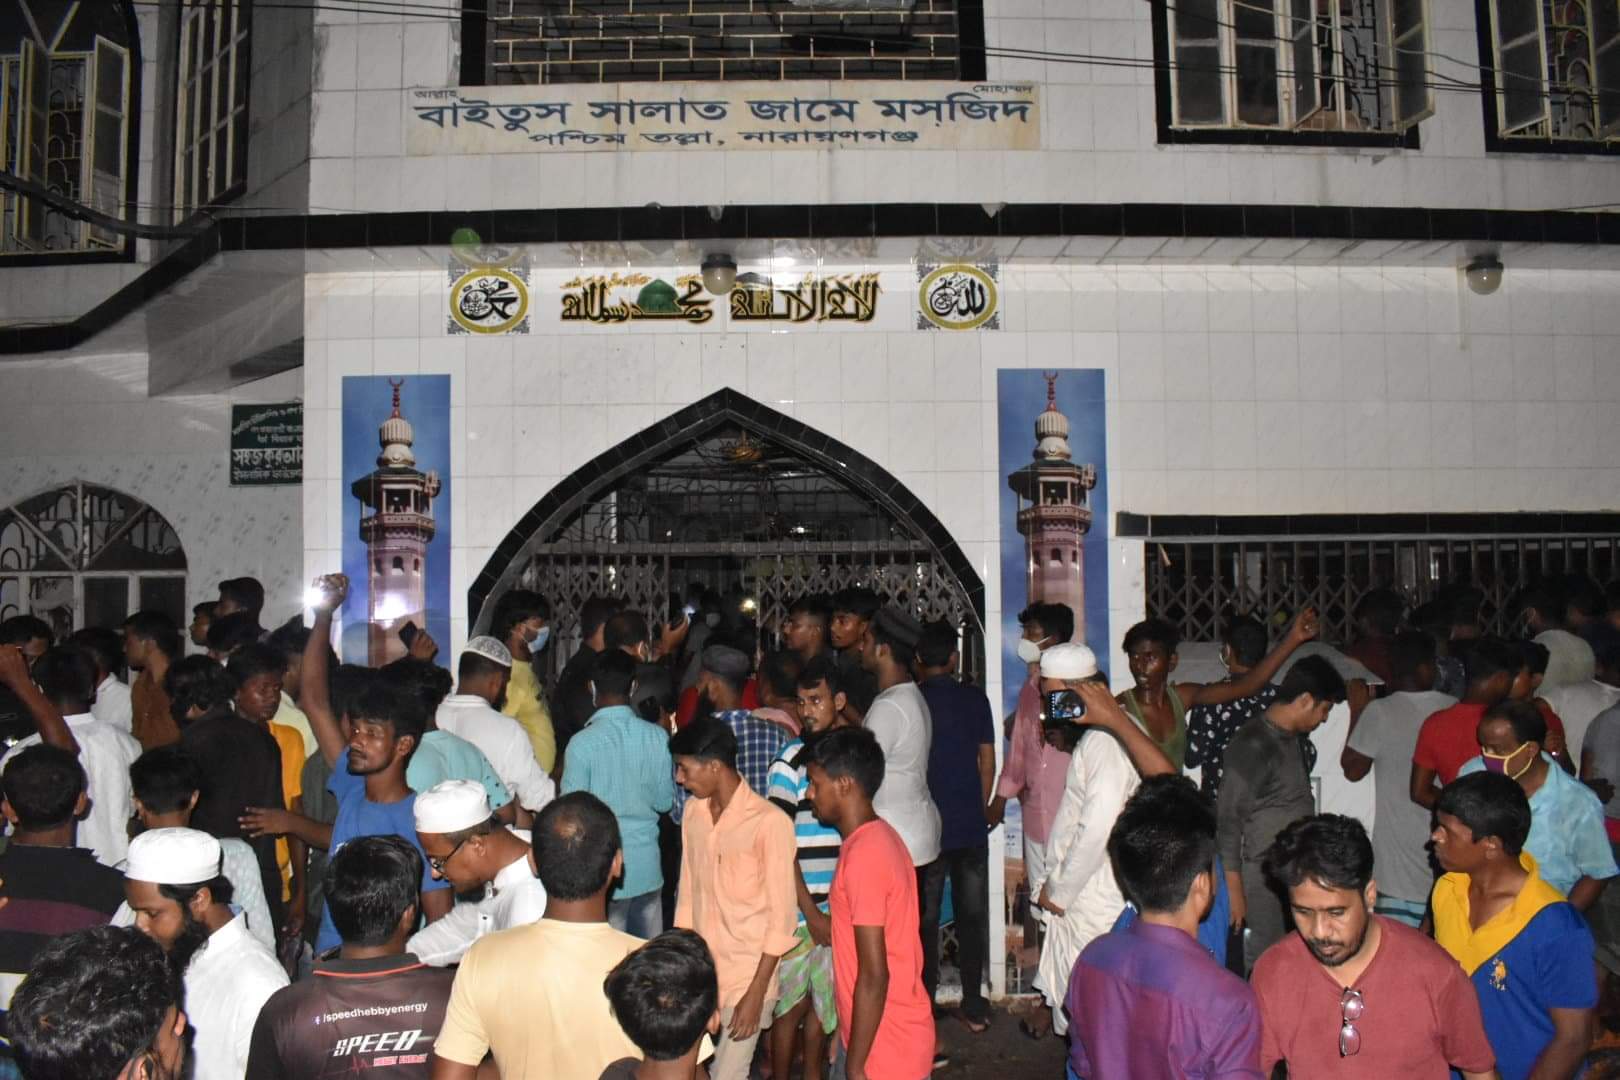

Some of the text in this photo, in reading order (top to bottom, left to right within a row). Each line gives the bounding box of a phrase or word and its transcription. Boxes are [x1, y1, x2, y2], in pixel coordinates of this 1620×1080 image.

[412, 96, 572, 132] বাইতুস
[587, 96, 730, 126] সালাত
[743, 97, 860, 123] জামে
[527, 130, 628, 146] পশ্চিম
[333, 1029, 422, 1057] SPEED
